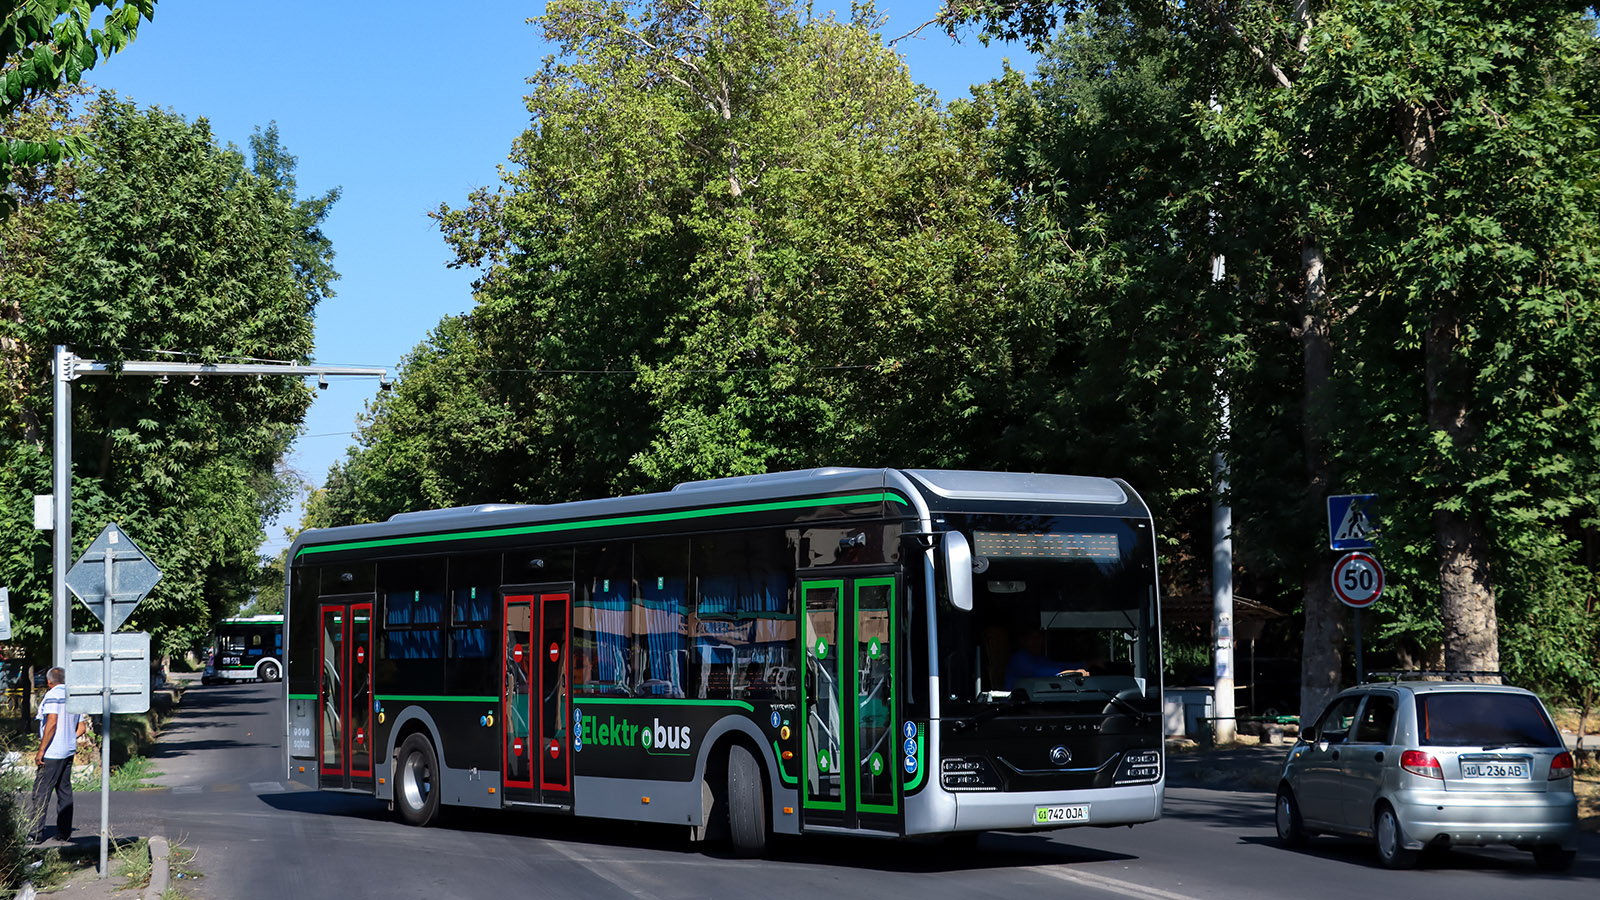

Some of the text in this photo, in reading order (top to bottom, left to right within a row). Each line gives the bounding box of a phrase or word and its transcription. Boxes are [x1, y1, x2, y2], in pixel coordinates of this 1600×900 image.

[1344, 569, 1373, 591] 50
[581, 715, 691, 750] Elektrobus
[1486, 765, 1506, 776] 236
[1508, 765, 1522, 777] AB
[1048, 809, 1064, 819] 742
